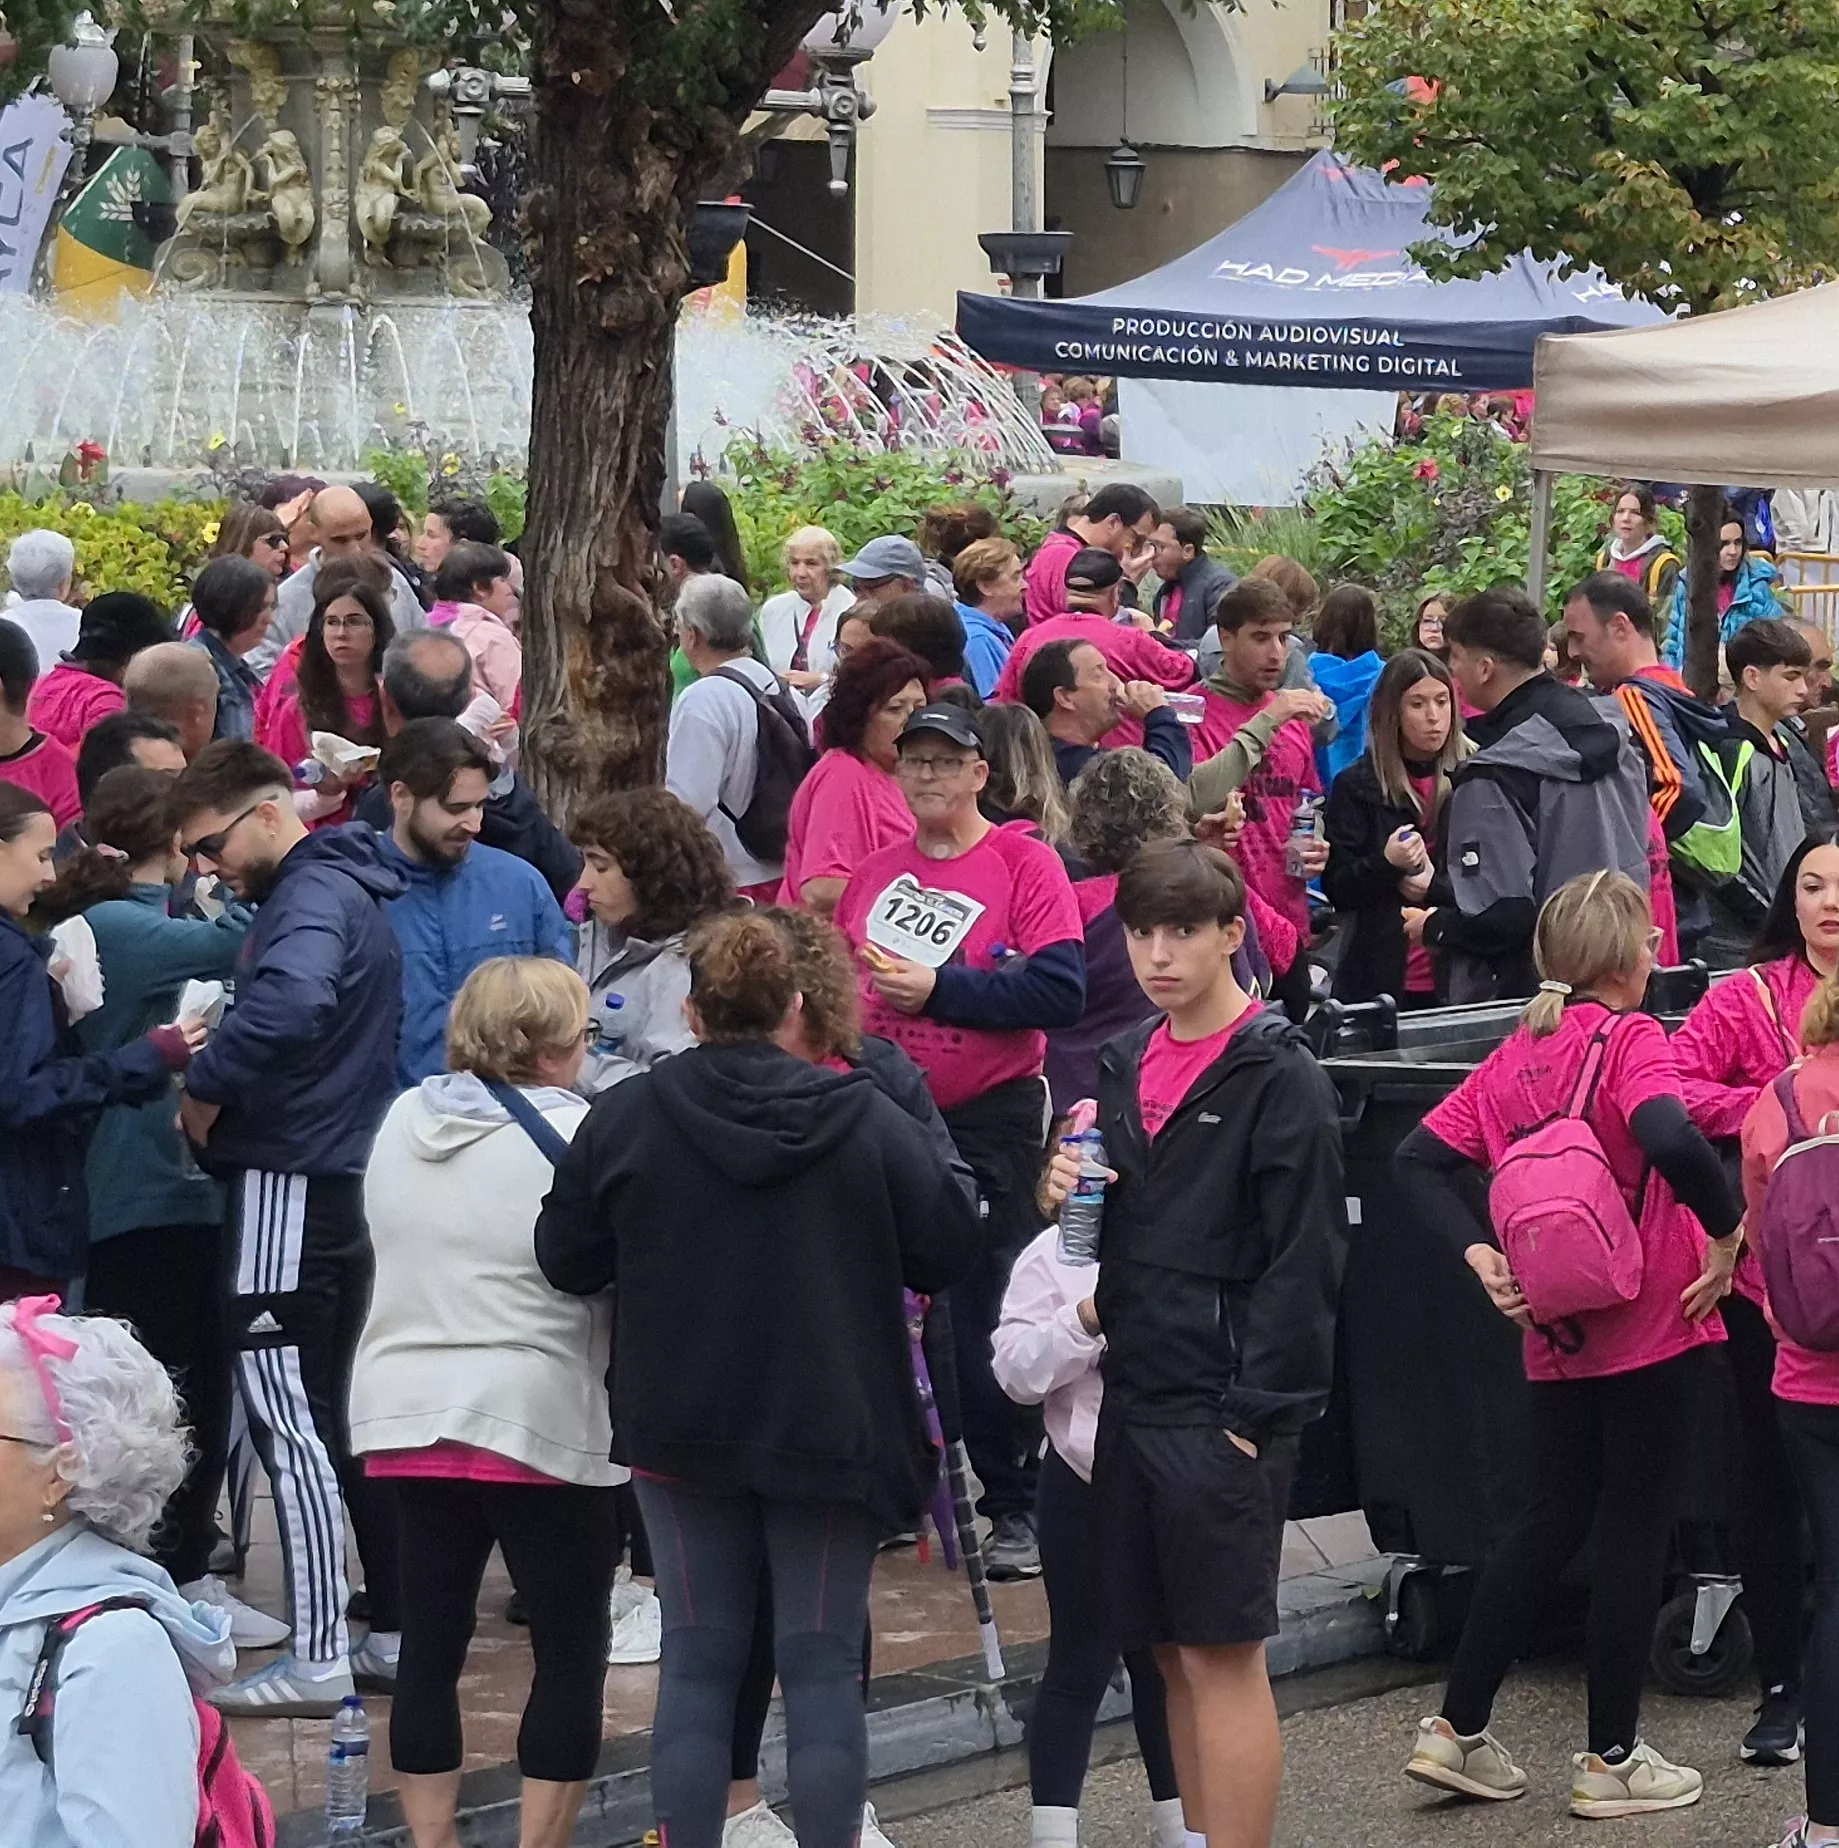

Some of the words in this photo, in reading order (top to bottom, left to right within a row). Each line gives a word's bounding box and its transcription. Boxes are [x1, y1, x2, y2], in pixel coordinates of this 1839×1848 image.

[1213, 259, 1310, 284] HAD
[1112, 316, 1252, 341] PRODUCCIÓN
[1257, 323, 1405, 347] AUDIOVISUAL
[1054, 341, 1219, 367] COMUNICACIÓN
[1225, 349, 1241, 368] &
[1245, 350, 1371, 374] MARKETING
[1377, 355, 1464, 377] DIGITAL
[883, 897, 957, 946] 1206
